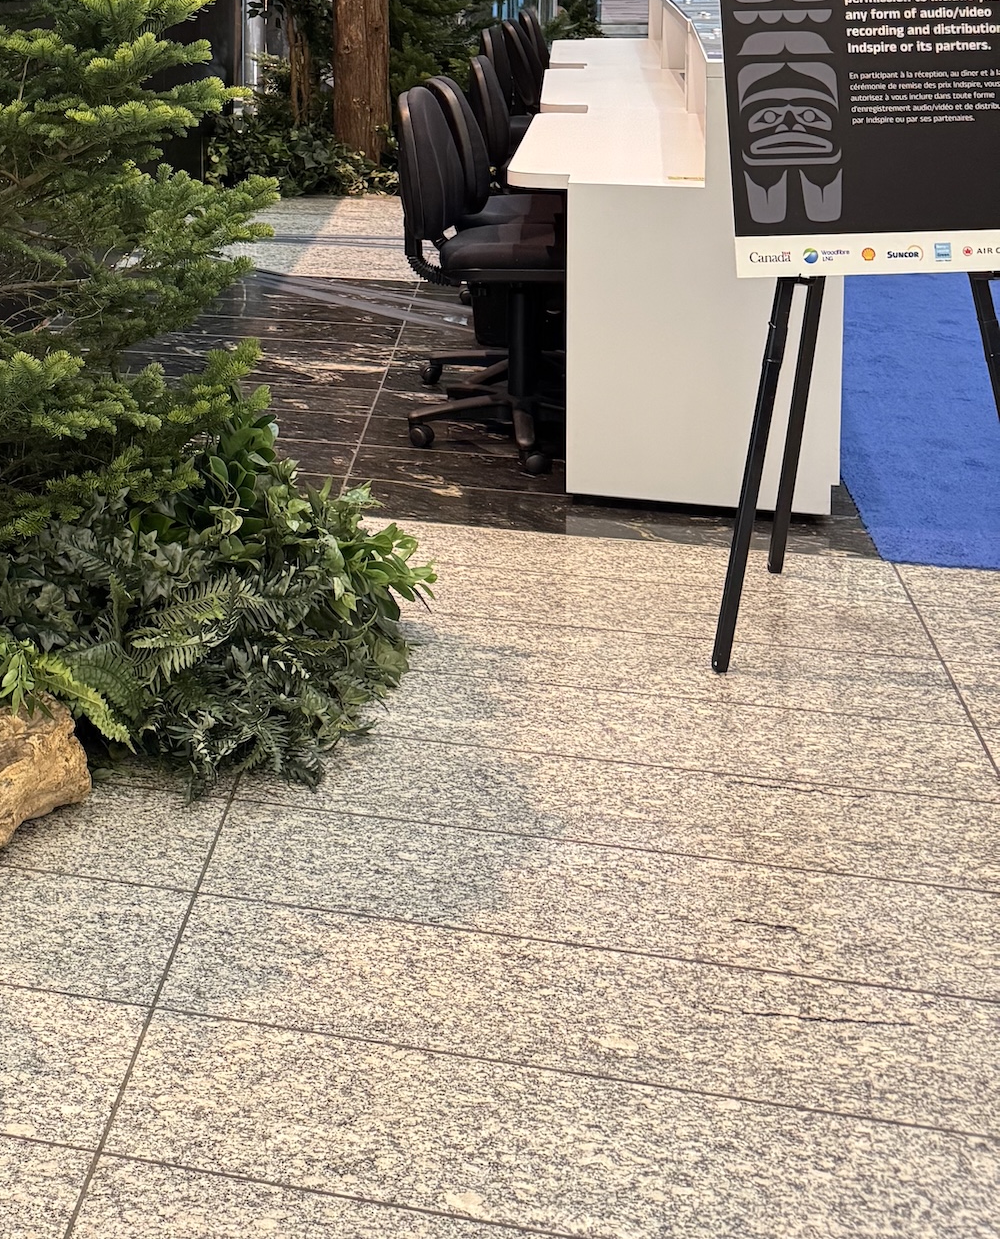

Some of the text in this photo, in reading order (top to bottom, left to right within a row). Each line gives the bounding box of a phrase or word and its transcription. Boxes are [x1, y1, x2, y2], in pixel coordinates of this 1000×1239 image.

[845, 6, 992, 22] any form of audio/video
[846, 25, 904, 38] recording
[907, 24, 930, 35] and
[848, 41, 992, 55] Indspire or its partners.
[860, 71, 898, 80] participant
[849, 83, 886, 91] cérémonie
[899, 81, 922, 89] remise
[923, 81, 936, 89] des
[938, 80, 952, 89] prix
[850, 94, 883, 102] autorisez
[934, 92, 951, 100] dans
[973, 91, 995, 99] forme
[964, 102, 973, 110] de
[852, 117, 864, 125] par
[866, 116, 894, 124] Indspire
[906, 116, 918, 124] par
[749, 250, 791, 263] Canada
